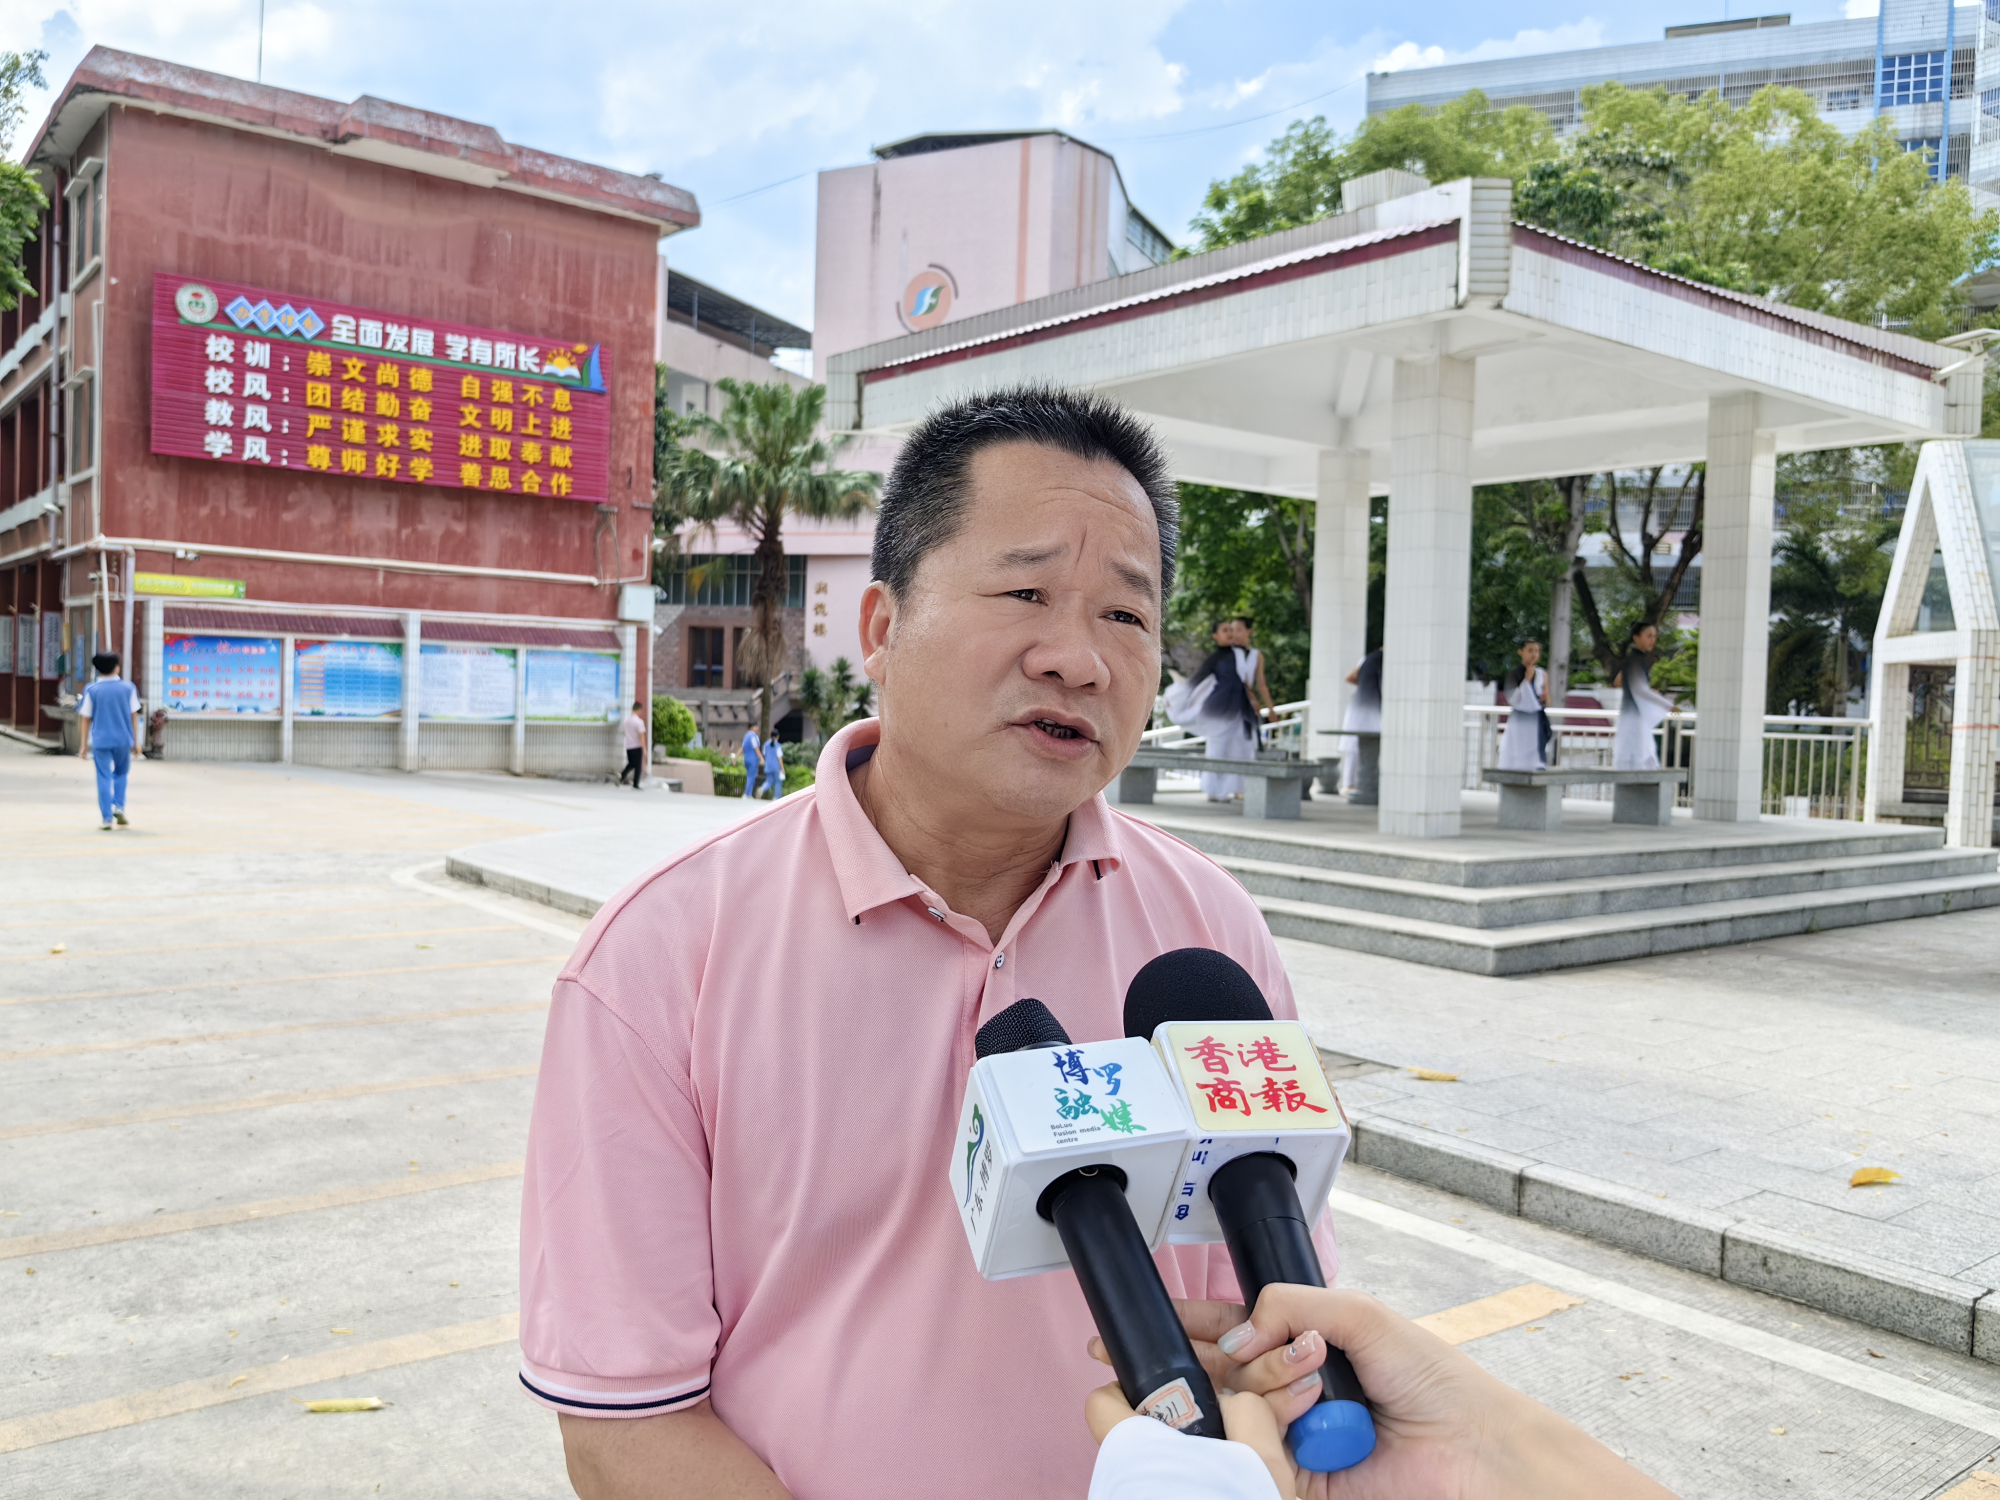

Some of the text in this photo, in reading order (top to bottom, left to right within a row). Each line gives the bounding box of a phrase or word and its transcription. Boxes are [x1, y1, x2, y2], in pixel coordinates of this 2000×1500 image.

[331, 314, 434, 357] 全面发展
[445, 333, 540, 373] 学有所长
[306, 350, 434, 393] 崇文尚德
[461, 374, 573, 412] 自强不息
[306, 381, 433, 422] 团结勤奋
[459, 403, 573, 441] 文明上进
[306, 413, 434, 453] 严谨求实
[459, 433, 573, 469] 进取奉献
[306, 444, 434, 482] 尊师好学
[459, 462, 573, 497] 善思合作
[1051, 1048, 1122, 1096] 博罗
[1184, 1035, 1297, 1075] 香港
[1053, 1088, 1147, 1135] 融媒
[1195, 1077, 1328, 1117] 商報
[1050, 1122, 1073, 1130] BoLuo
[1053, 1126, 1101, 1137] Fusion media
